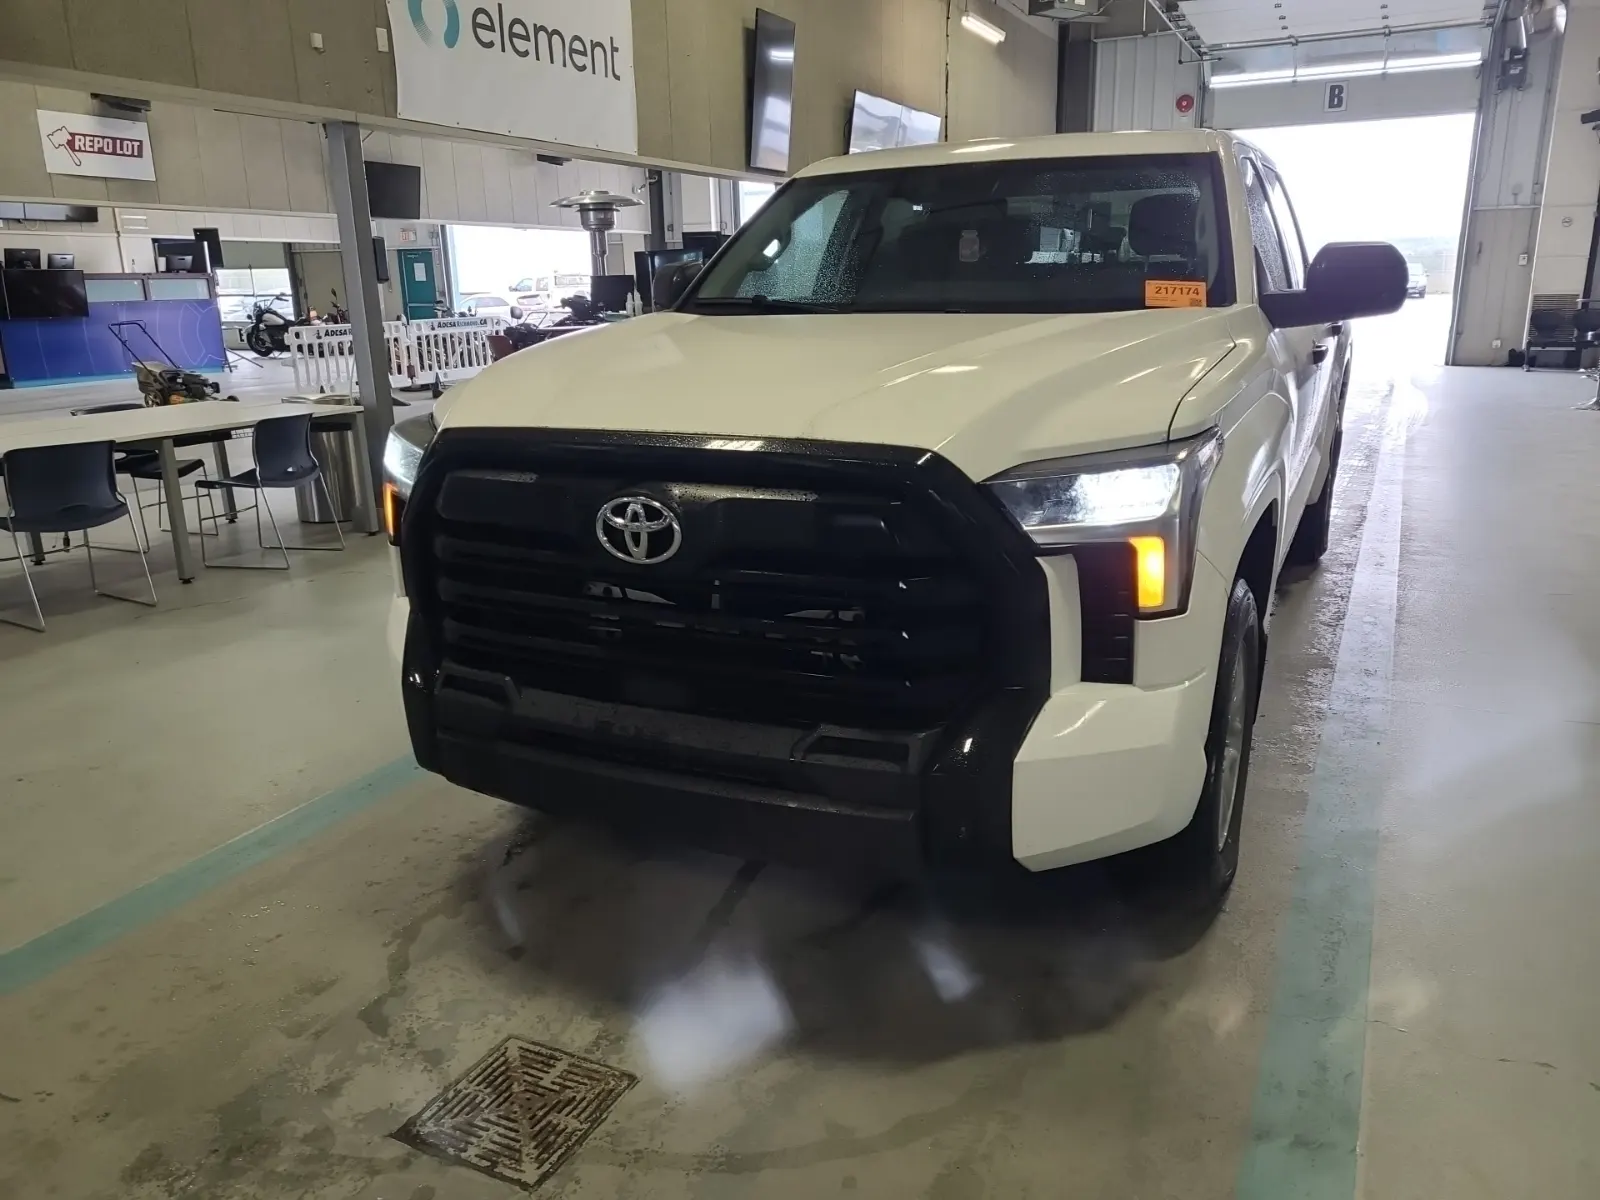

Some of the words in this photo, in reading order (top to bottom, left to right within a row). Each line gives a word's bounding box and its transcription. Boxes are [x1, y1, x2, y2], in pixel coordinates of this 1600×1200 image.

[472, 3, 620, 81] element
[1328, 85, 1344, 108] B
[74, 135, 112, 153] REPO
[116, 139, 140, 156] LOT
[1155, 286, 1199, 296] 217174
